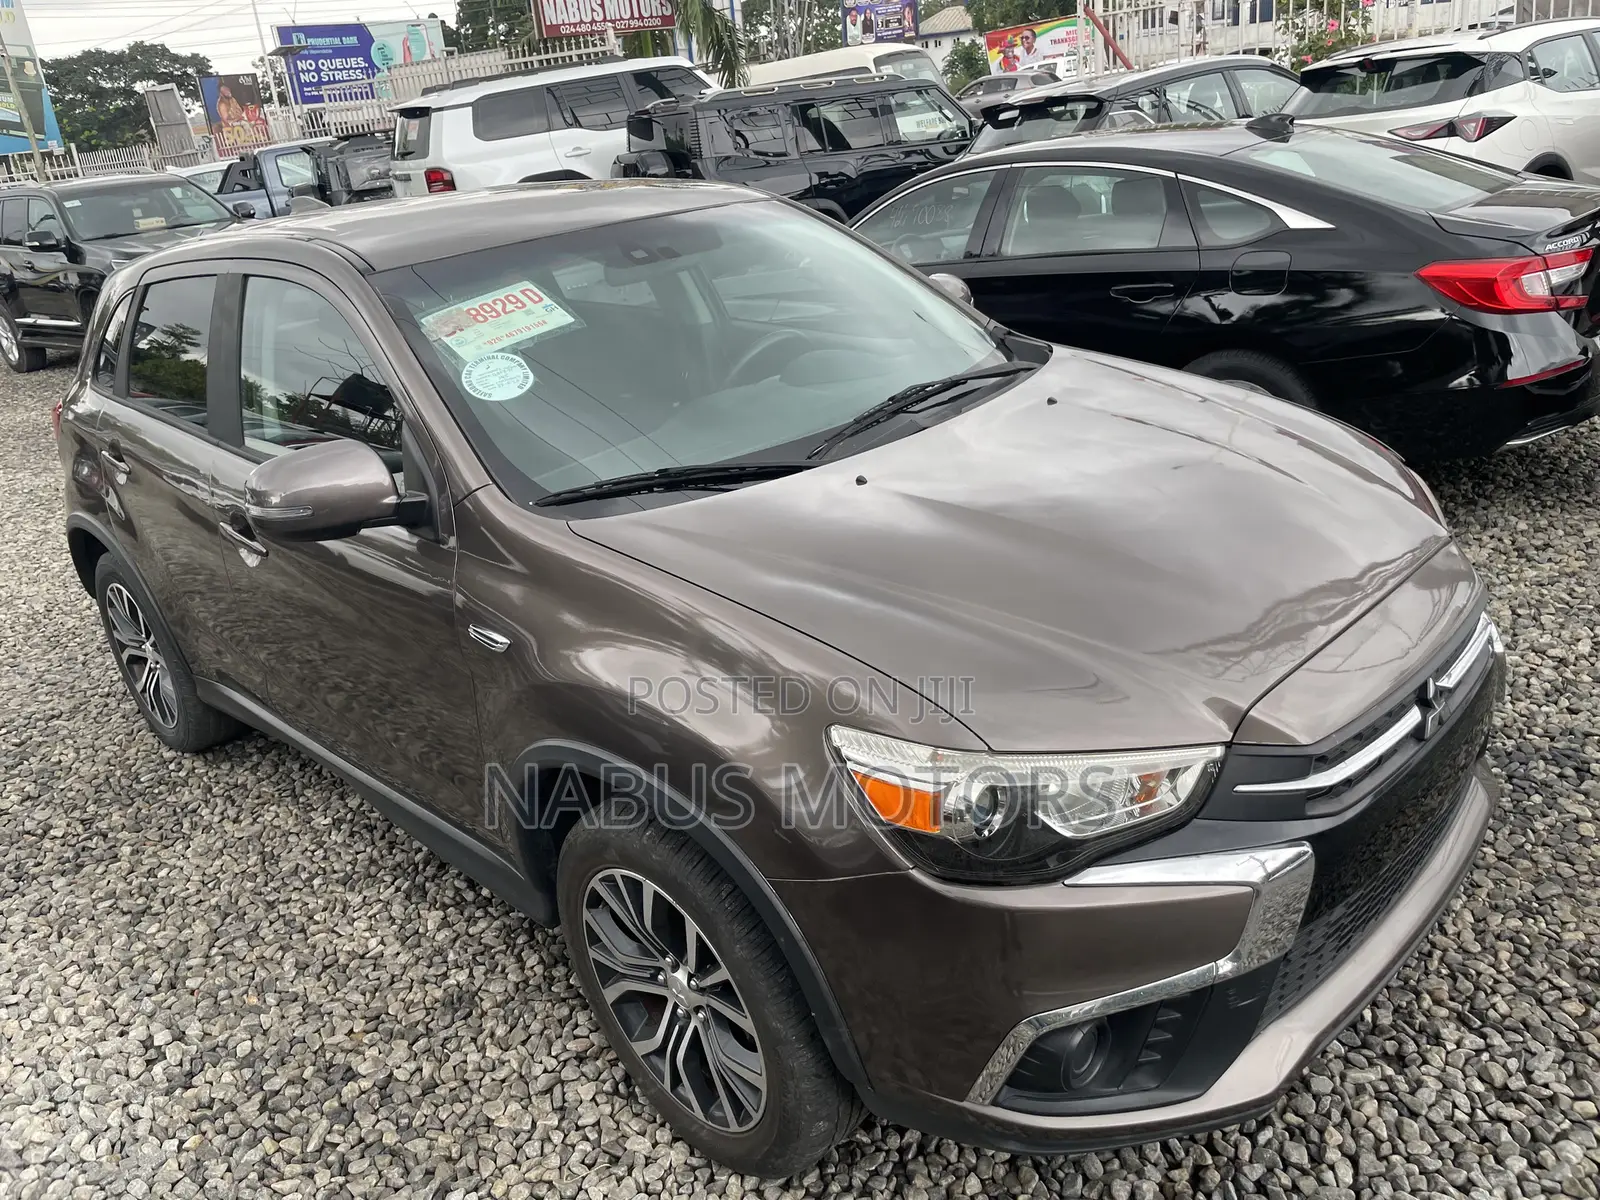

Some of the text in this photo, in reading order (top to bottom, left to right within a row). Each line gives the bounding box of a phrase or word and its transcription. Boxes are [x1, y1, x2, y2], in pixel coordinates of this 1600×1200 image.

[542, 0, 673, 25] NABUS MOTORS
[560, 25, 576, 34] 024
[576, 23, 592, 32] 480
[615, 20, 629, 29] 027
[629, 19, 643, 28] 994
[643, 17, 662, 26] 0200
[296, 57, 369, 71] NO QUEUES.
[300, 69, 366, 83] NO STRESS.
[1545, 236, 1580, 251] ACCORD
[465, 293, 527, 324] 8929
[519, 288, 544, 305] D
[469, 354, 500, 369] TERMINAL
[500, 354, 528, 371] COMPANY
